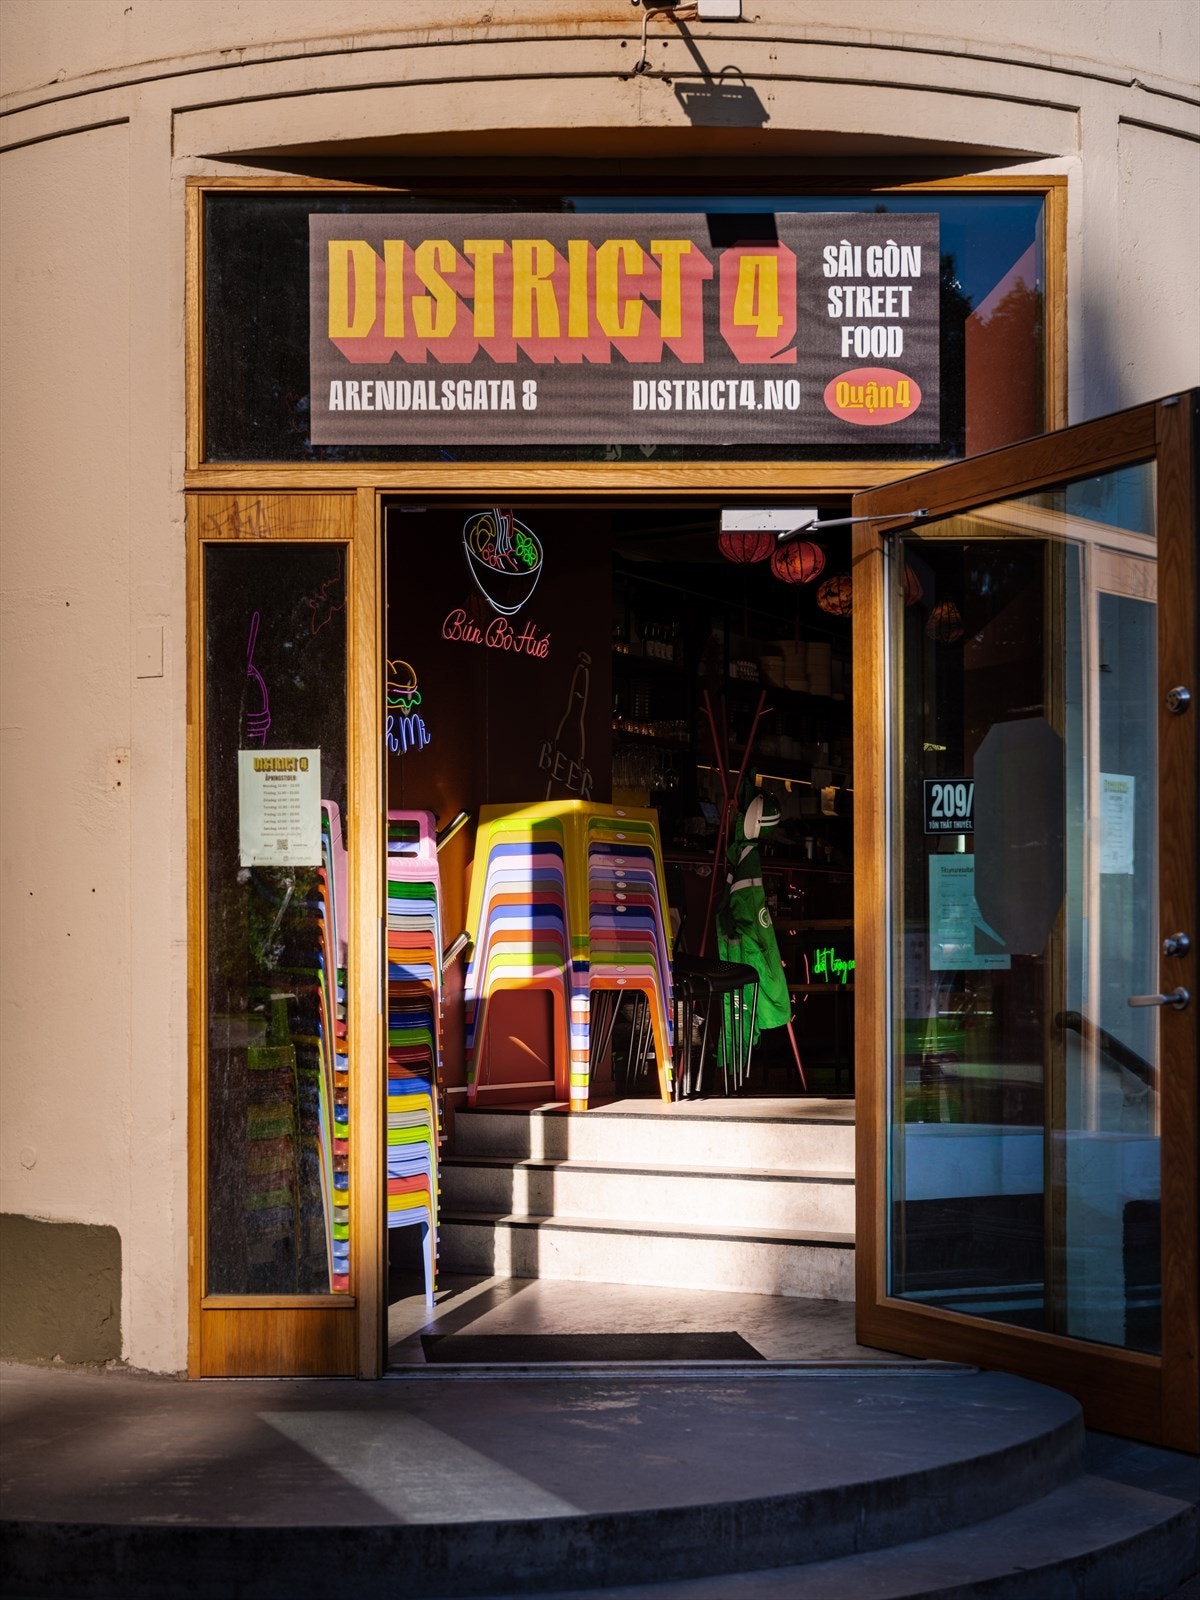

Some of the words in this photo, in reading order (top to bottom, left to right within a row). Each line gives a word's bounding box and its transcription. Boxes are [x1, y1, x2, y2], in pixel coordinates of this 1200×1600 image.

[822, 239, 862, 278] SÀI
[866, 239, 922, 278] GÒN
[328, 239, 696, 341] DISTRICT
[733, 255, 784, 338] 4
[827, 285, 913, 318] STREET
[841, 326, 904, 359] FOOD
[328, 380, 516, 411] ARENDALSGATA
[522, 380, 538, 411] 8
[632, 380, 801, 411] DISTRICT4.NO
[538, 739, 593, 796] BEER
